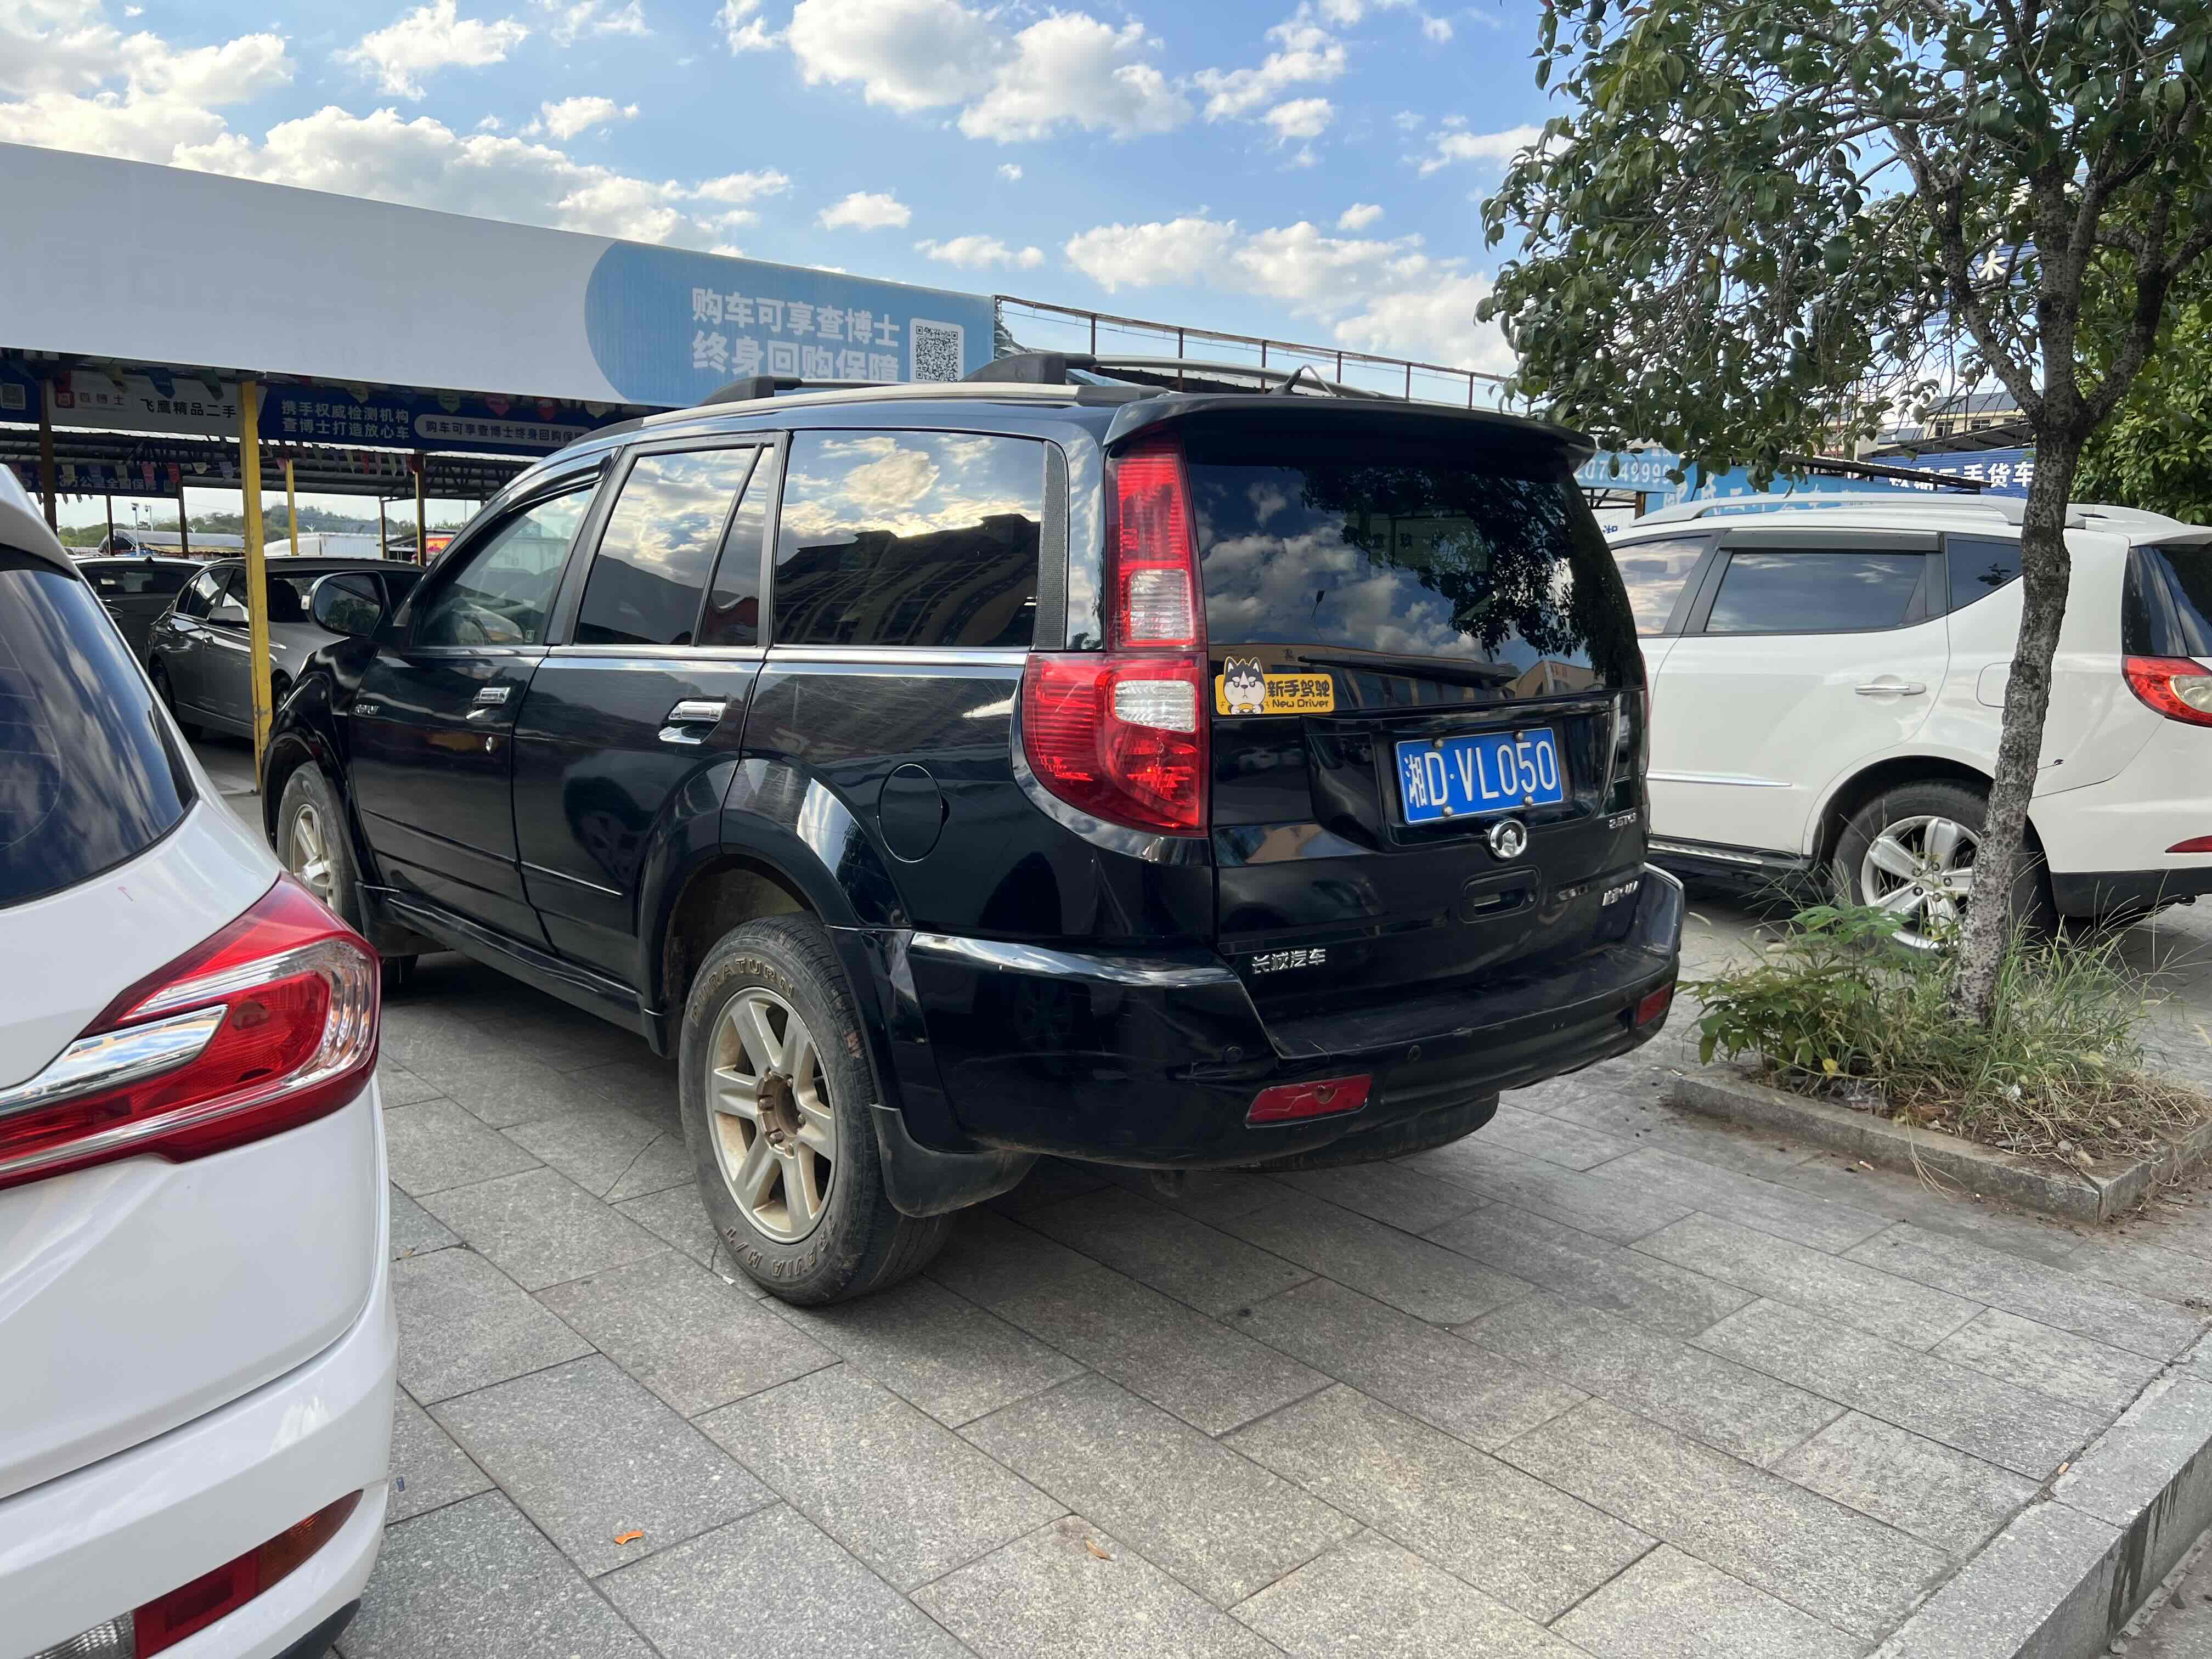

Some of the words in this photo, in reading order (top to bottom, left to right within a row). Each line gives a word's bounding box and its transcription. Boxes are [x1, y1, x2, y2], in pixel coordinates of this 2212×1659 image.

[691, 287, 900, 347] 购车可享查博士
[692, 330, 900, 382] 终身回购保障
[281, 399, 409, 424] 携手权威检测机构
[282, 417, 410, 439] 查博士打造放心车
[1267, 679, 1330, 698] 新手驾驶
[1272, 699, 1294, 708] New
[1297, 698, 1329, 708] Driver
[1251, 948, 1326, 975] 长城汽车
[690, 956, 794, 1028] DURATURN
